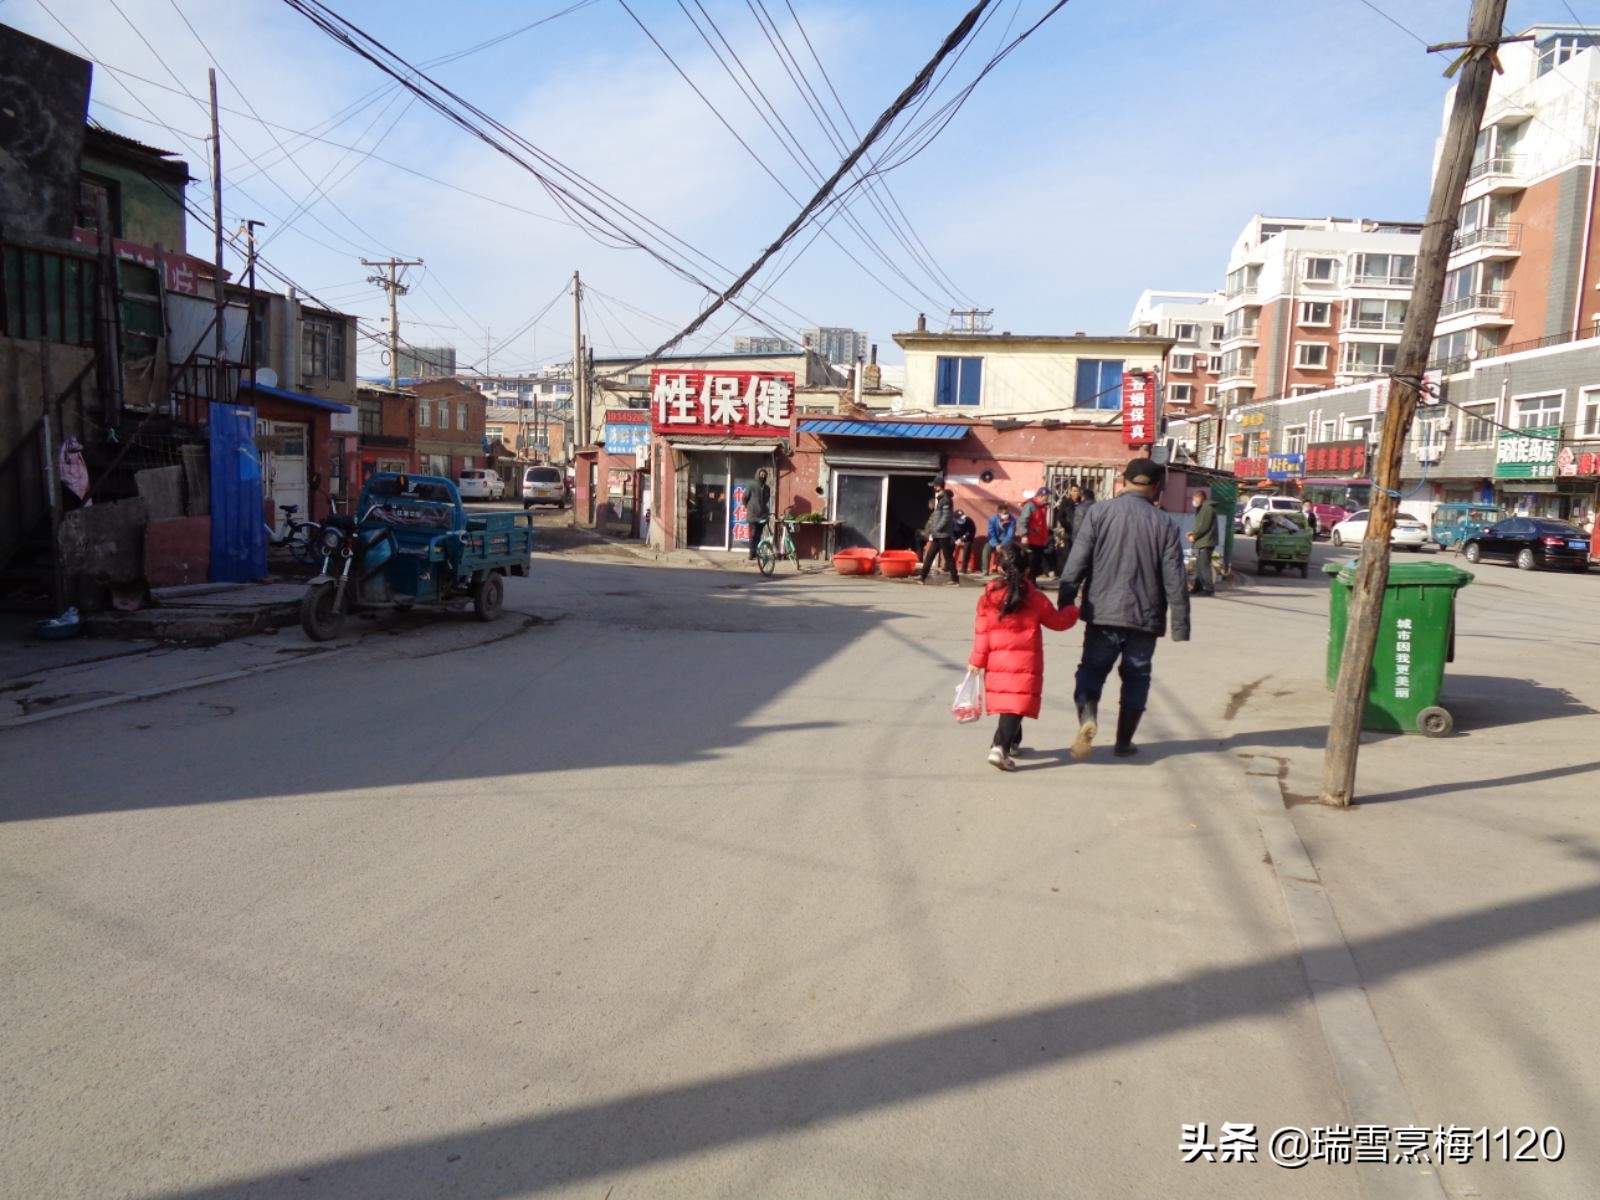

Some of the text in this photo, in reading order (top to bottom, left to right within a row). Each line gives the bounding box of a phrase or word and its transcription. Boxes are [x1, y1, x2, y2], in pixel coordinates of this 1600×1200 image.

[654, 373, 792, 427] 性保健
[1394, 618, 1413, 699] 城市因我更美丽
